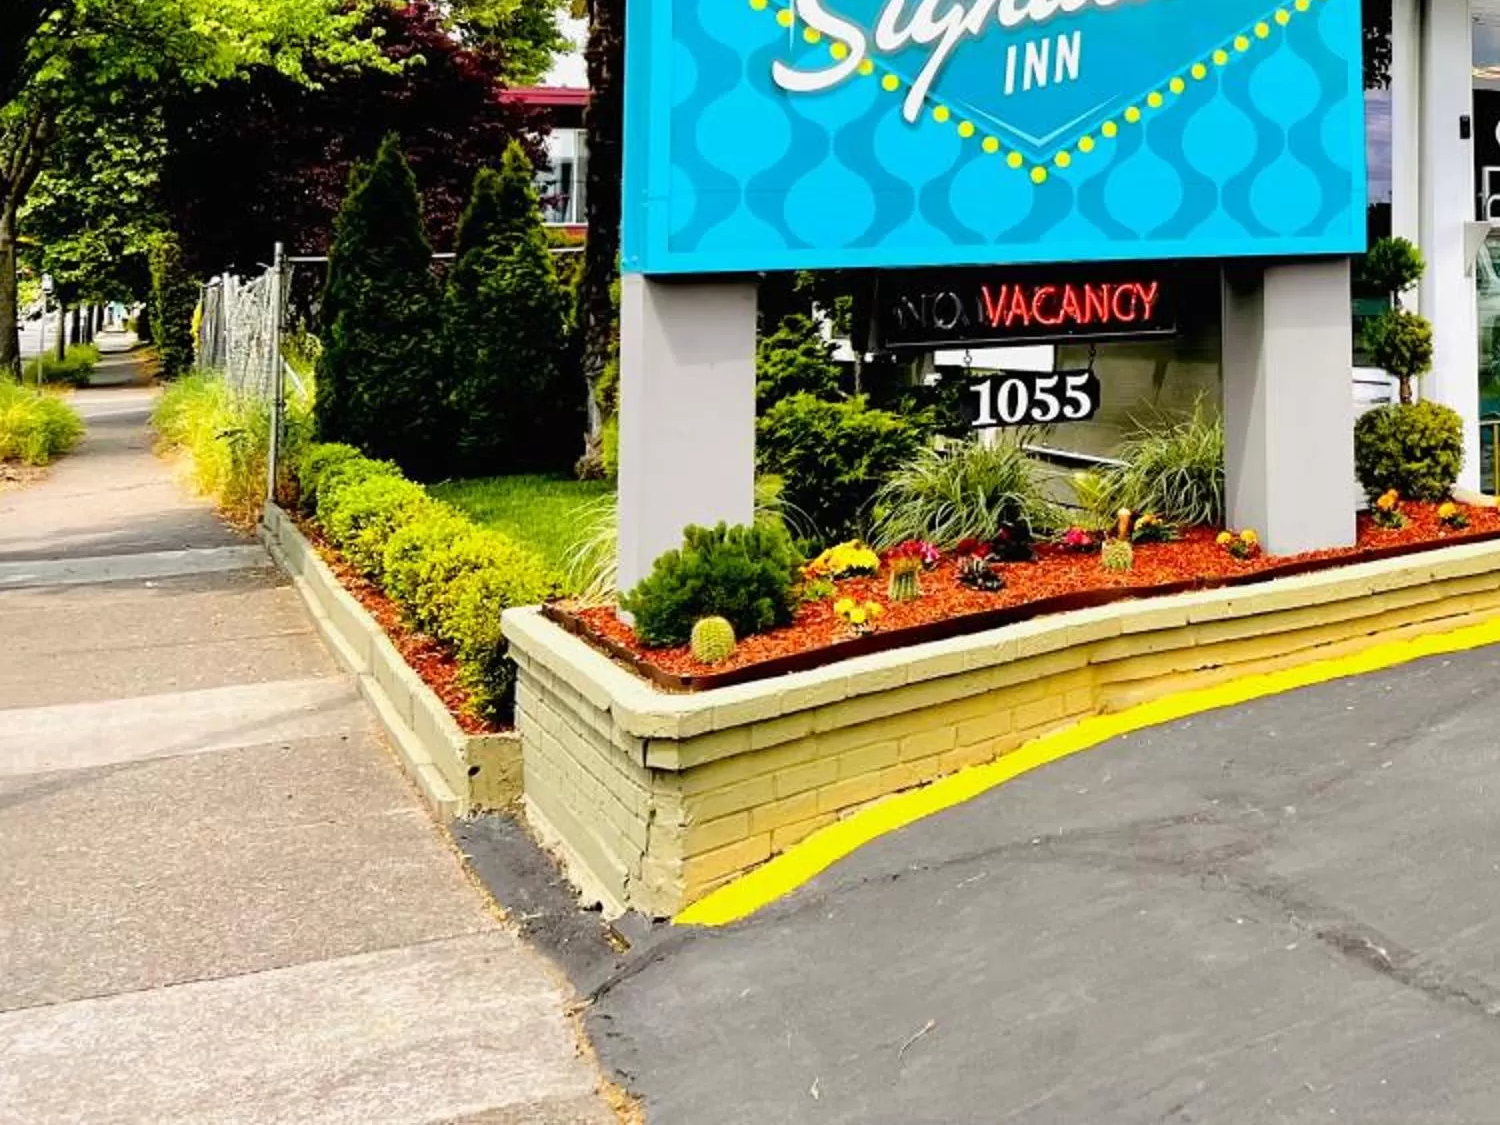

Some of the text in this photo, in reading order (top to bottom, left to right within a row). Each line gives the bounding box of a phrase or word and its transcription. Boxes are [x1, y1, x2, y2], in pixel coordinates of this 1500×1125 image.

[1004, 31, 1082, 95] INN
[896, 281, 1159, 329] NO VACANCY
[969, 373, 1091, 426] 1055
